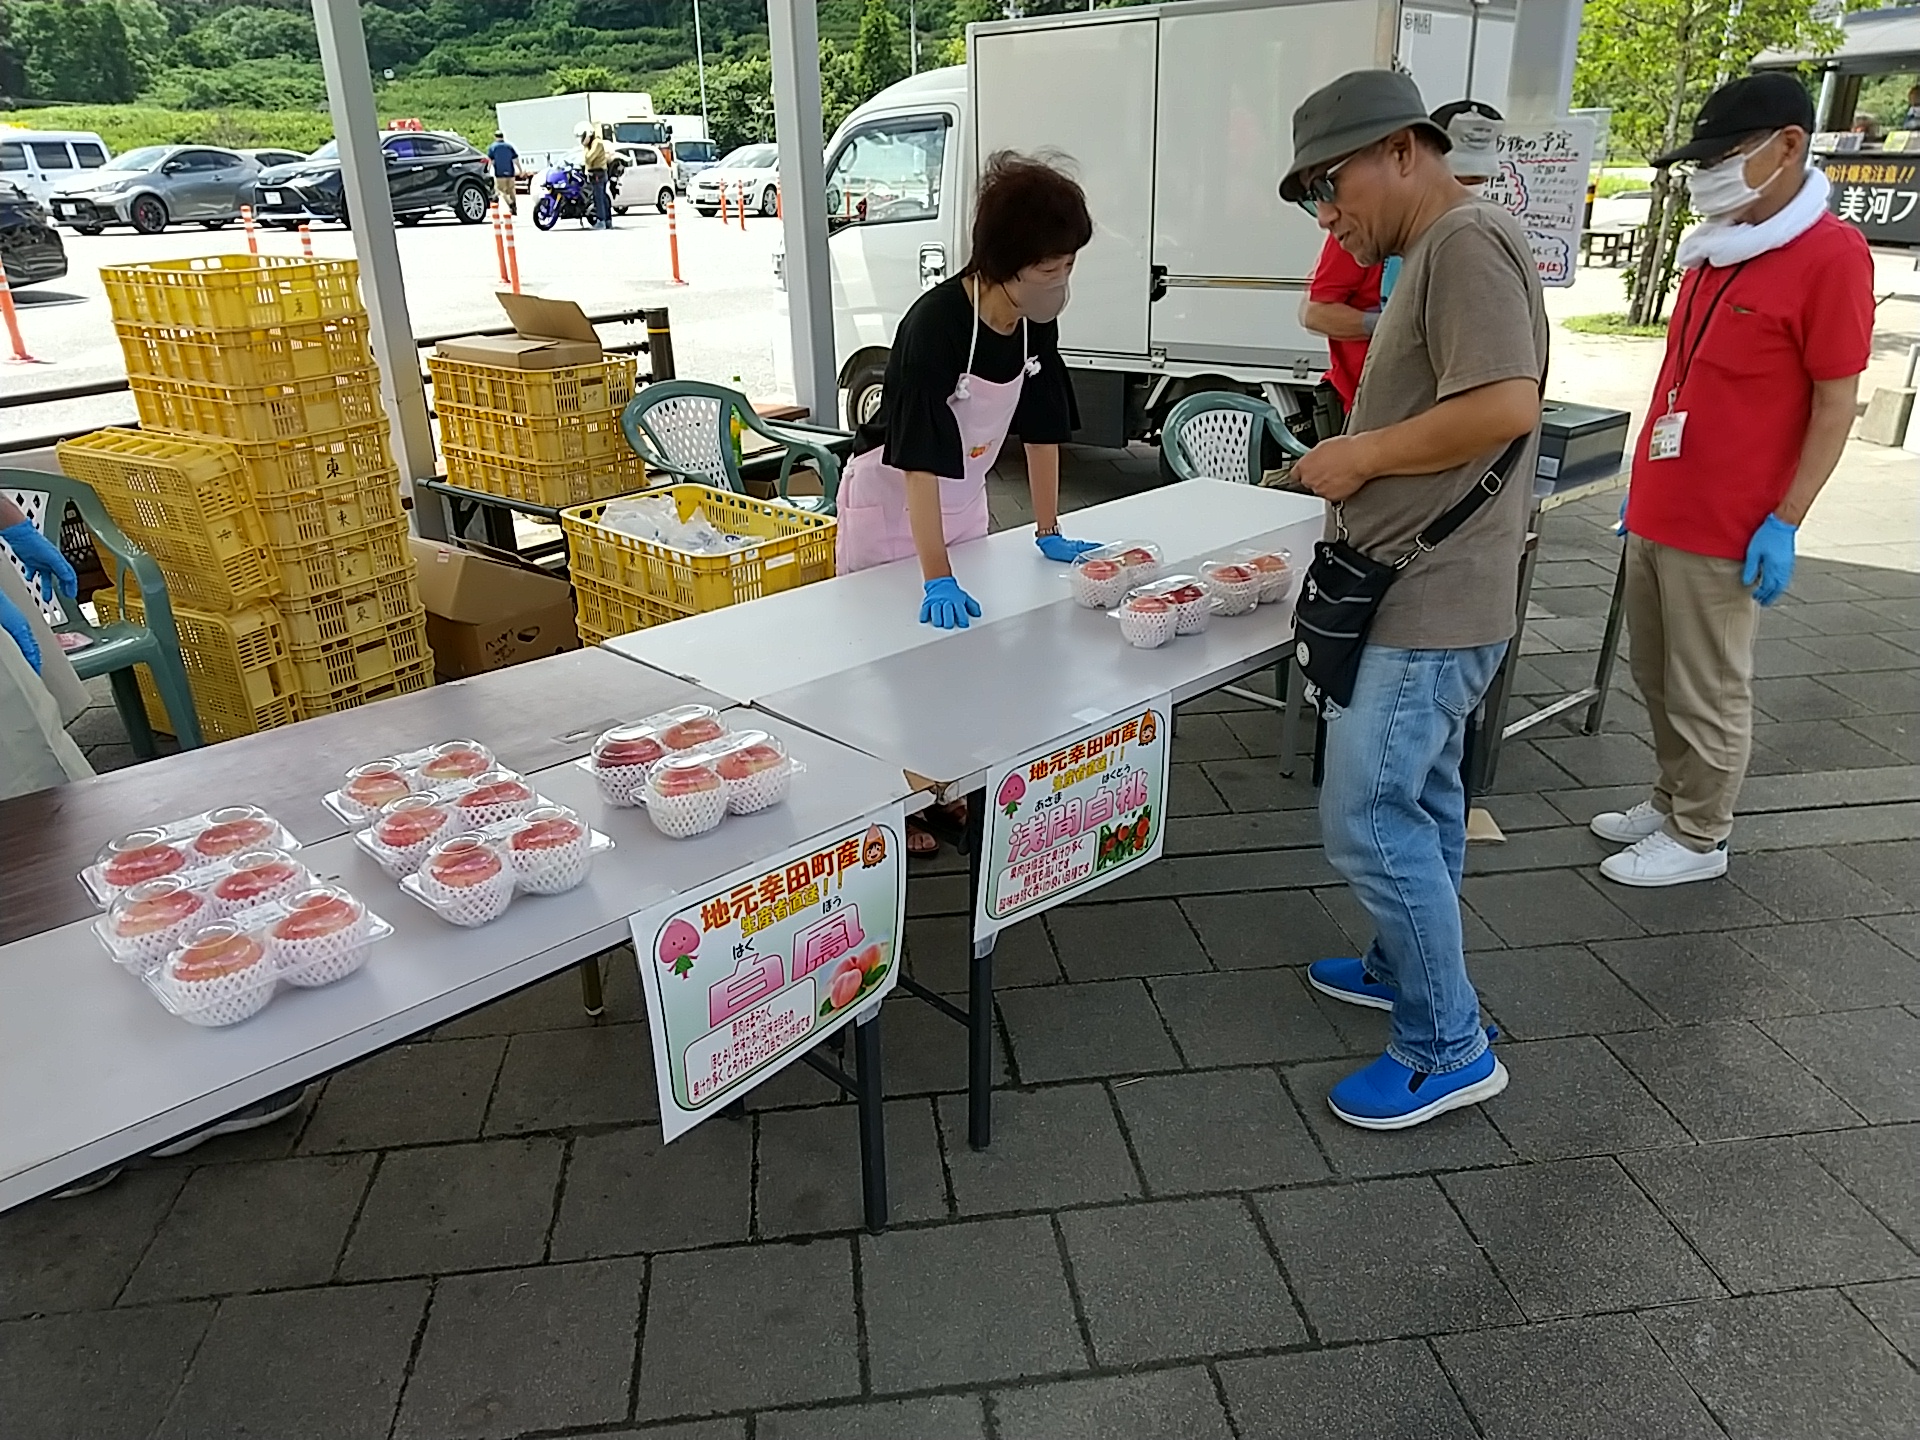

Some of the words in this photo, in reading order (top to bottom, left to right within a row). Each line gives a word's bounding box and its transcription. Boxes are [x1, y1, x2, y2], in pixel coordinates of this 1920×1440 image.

[326, 457, 344, 479] 東
[1028, 719, 1139, 783] 地元幸田町産
[1101, 764, 1131, 784] はくとう
[1007, 767, 1149, 863] 浅間白桃
[1034, 791, 1062, 811] あさま
[700, 838, 861, 934] 地元幸田町産
[709, 902, 866, 1029] 白鳳
[732, 937, 755, 961] はく
